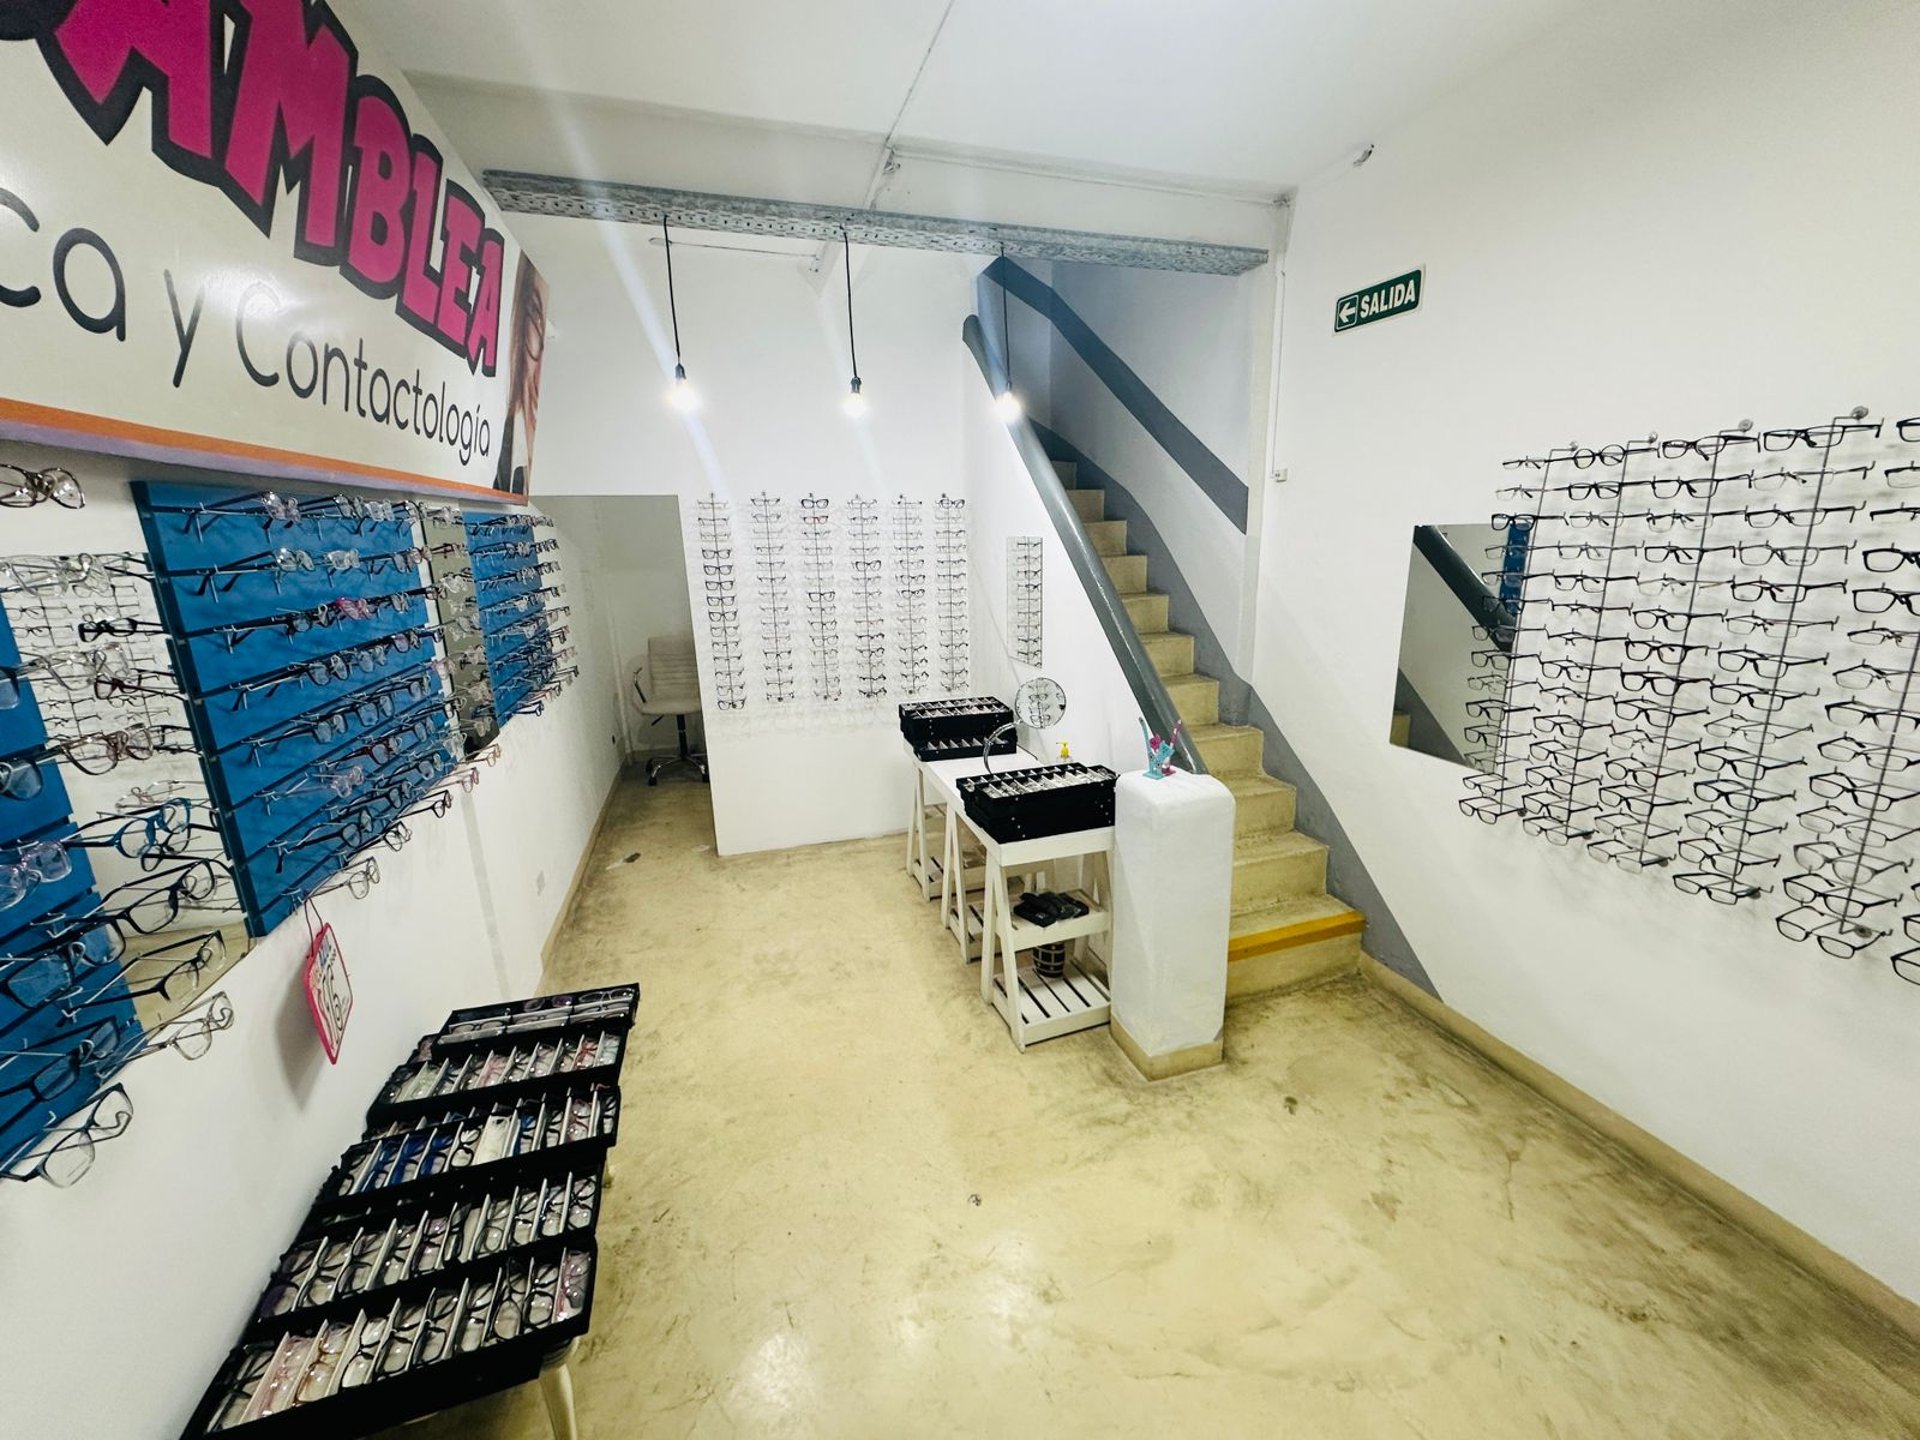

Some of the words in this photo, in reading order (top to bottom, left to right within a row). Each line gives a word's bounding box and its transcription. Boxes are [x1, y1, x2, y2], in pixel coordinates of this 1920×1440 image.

[1360, 279, 1416, 318] SALIDA
[163, 268, 205, 388] y
[235, 281, 490, 466] Contactología
